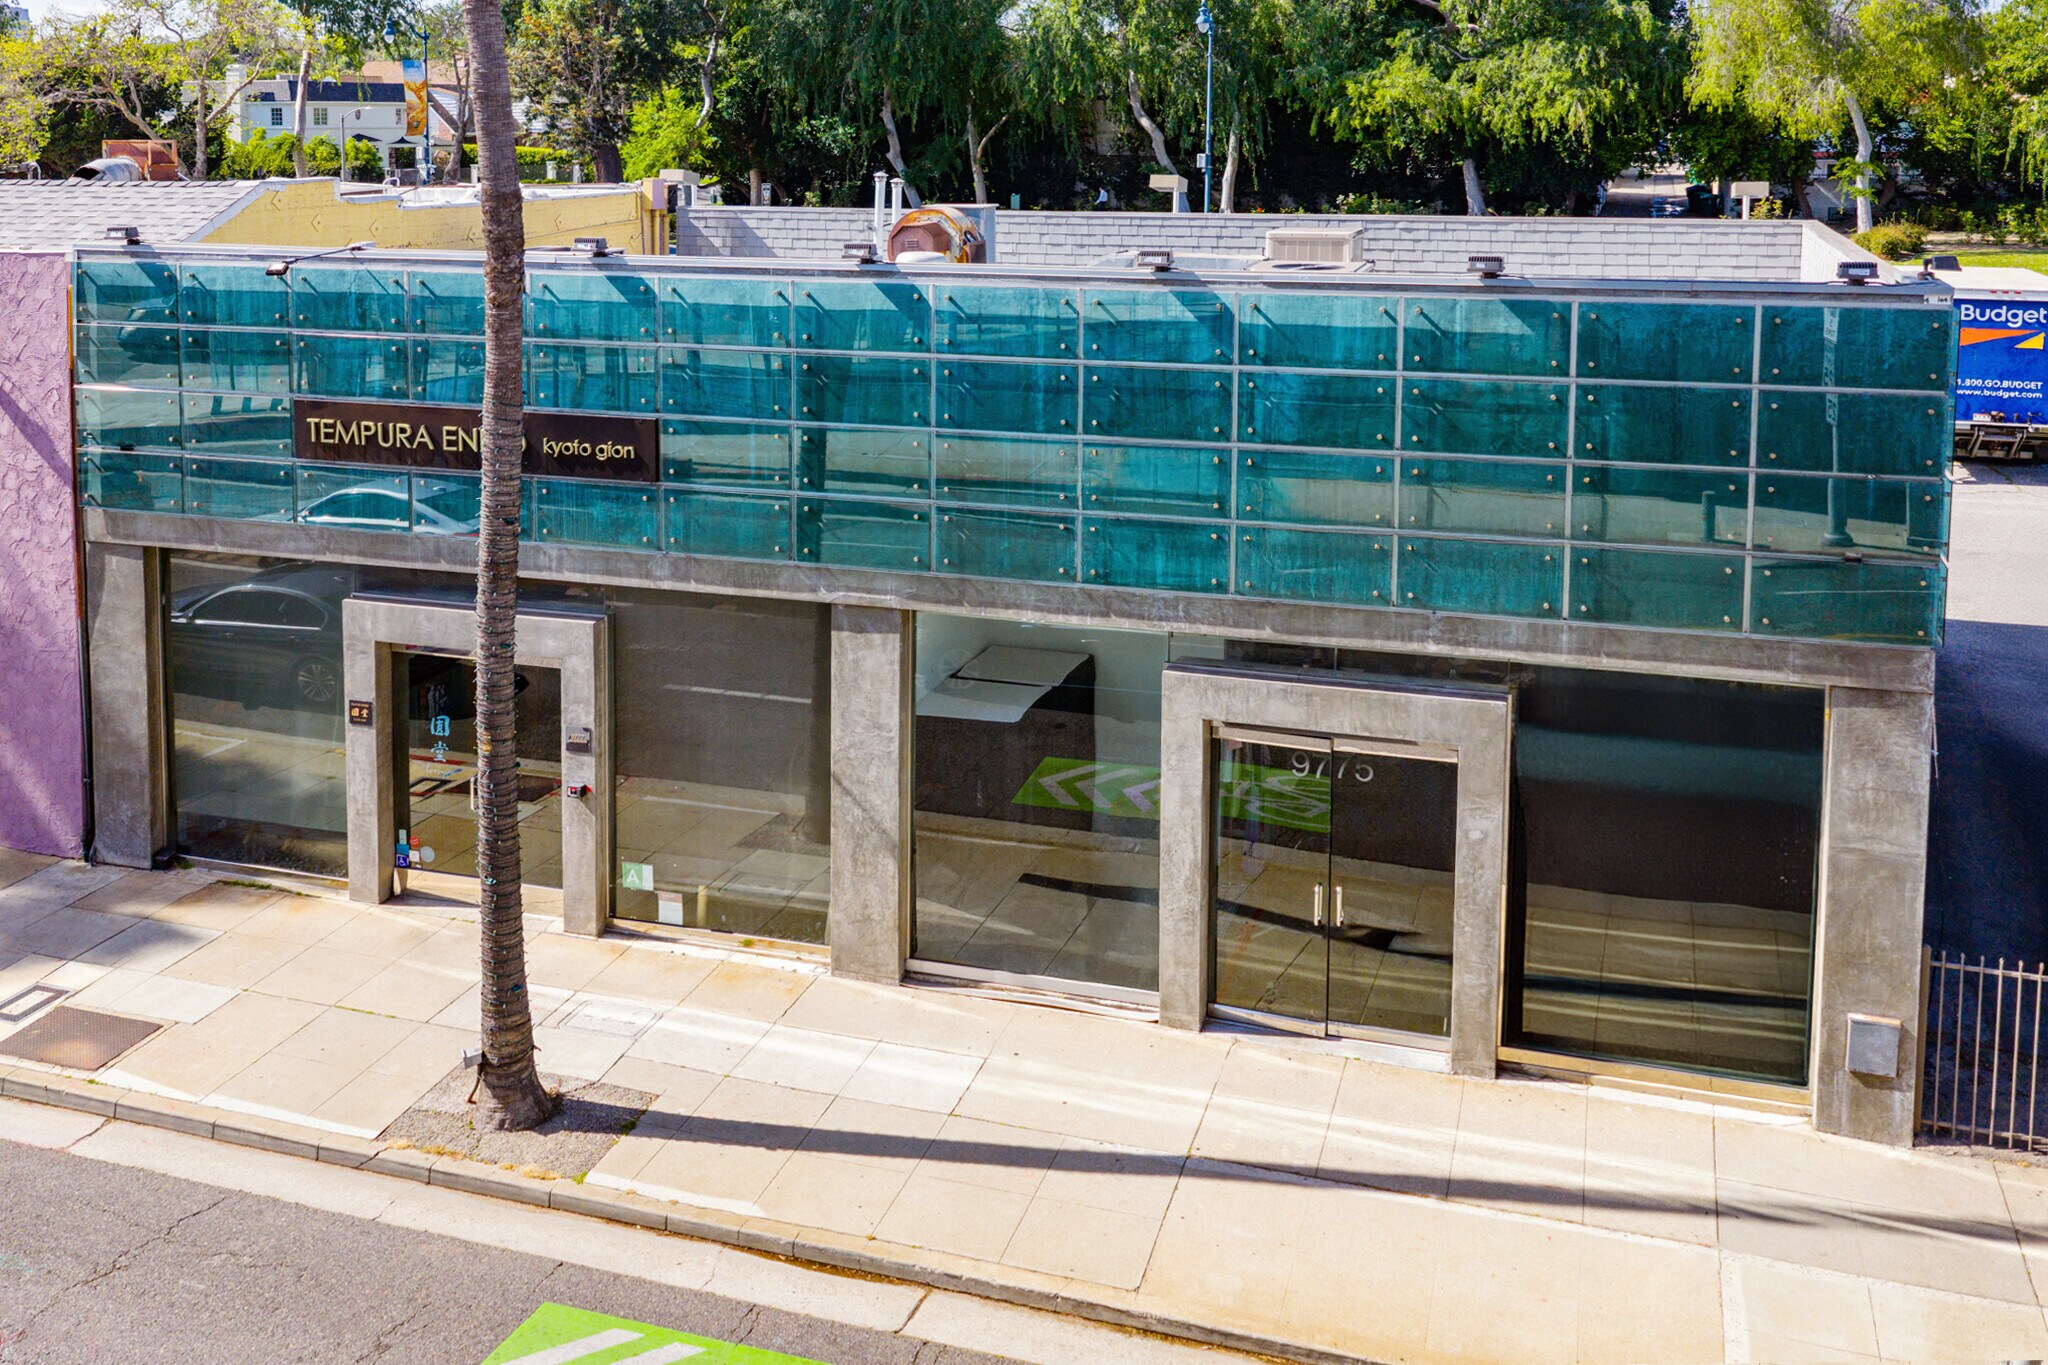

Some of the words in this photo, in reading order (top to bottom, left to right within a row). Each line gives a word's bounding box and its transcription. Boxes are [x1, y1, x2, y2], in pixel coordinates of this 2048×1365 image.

[1960, 304, 2047, 327] Budget
[1957, 378, 2043, 390] 1.800.GO.BUDGET
[1956, 388, 2043, 399] www.budget.com
[306, 417, 435, 450] TEMPURA
[442, 425, 527, 452] EN
[542, 437, 592, 458] kyoto
[595, 442, 635, 461] gion
[626, 869, 640, 884] A
